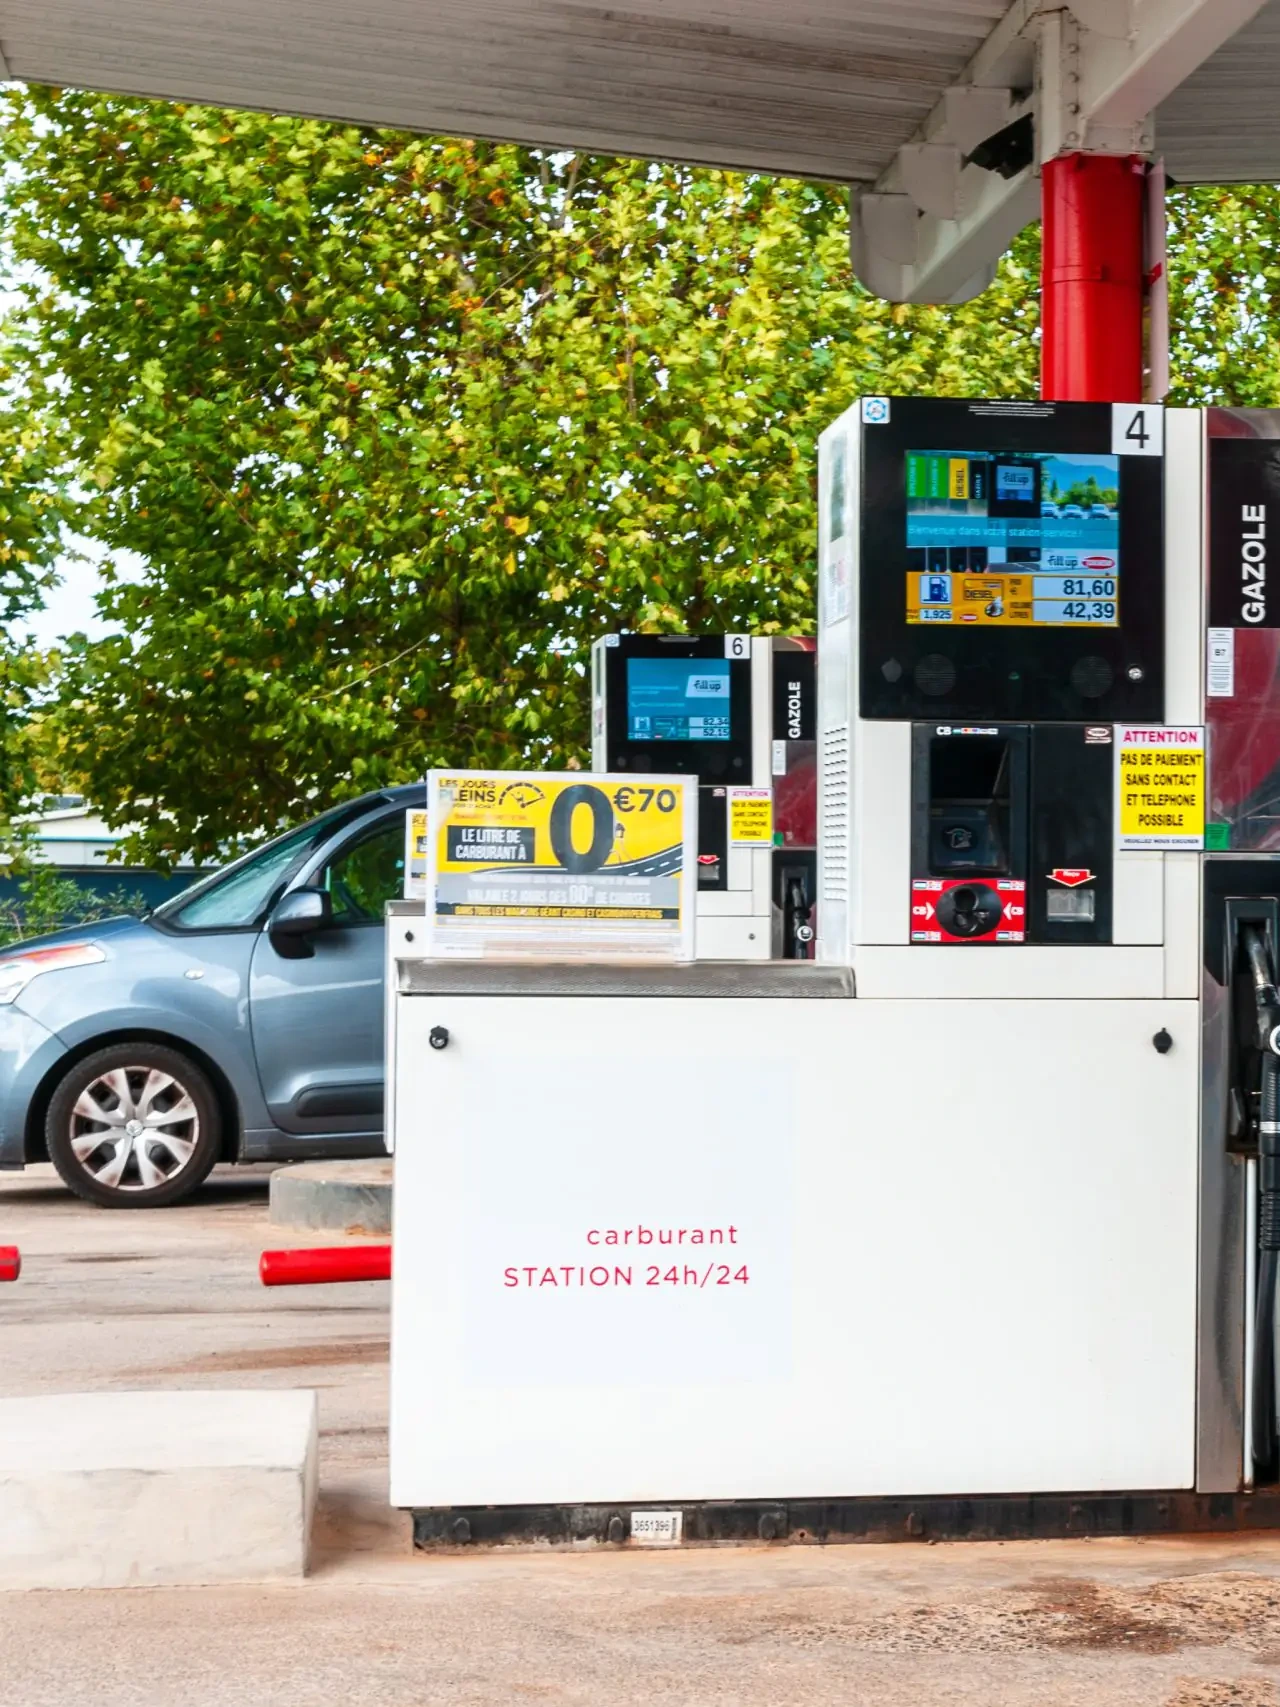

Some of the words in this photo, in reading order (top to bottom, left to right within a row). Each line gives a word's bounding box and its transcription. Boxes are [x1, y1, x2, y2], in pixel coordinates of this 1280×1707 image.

[1125, 410, 1150, 449] 4
[1241, 504, 1266, 623] GAZOLE
[1063, 579, 1115, 598] 81,60
[1063, 603, 1115, 621] 42,39
[732, 637, 744, 656] 6
[788, 681, 801, 739] GAZOLE
[1124, 731, 1198, 742] ATTENTION
[1120, 753, 1137, 765] PAS
[1140, 753, 1152, 765] DE
[1155, 753, 1202, 765] PAIEMENT
[461, 780, 496, 789] JOURS
[1126, 774, 1150, 786] SANS
[1153, 774, 1197, 786] CONTACT
[1126, 794, 1138, 806] ET
[1138, 814, 1184, 826] POSSIBLE
[461, 828, 475, 842] LE
[476, 829, 505, 843] LITRE
[506, 829, 521, 843] DE
[455, 844, 517, 859] CARBURANT
[518, 844, 527, 860] À
[587, 1225, 738, 1245] carburant
[504, 1266, 632, 1287] STATION
[646, 1262, 749, 1288] 24h/24
